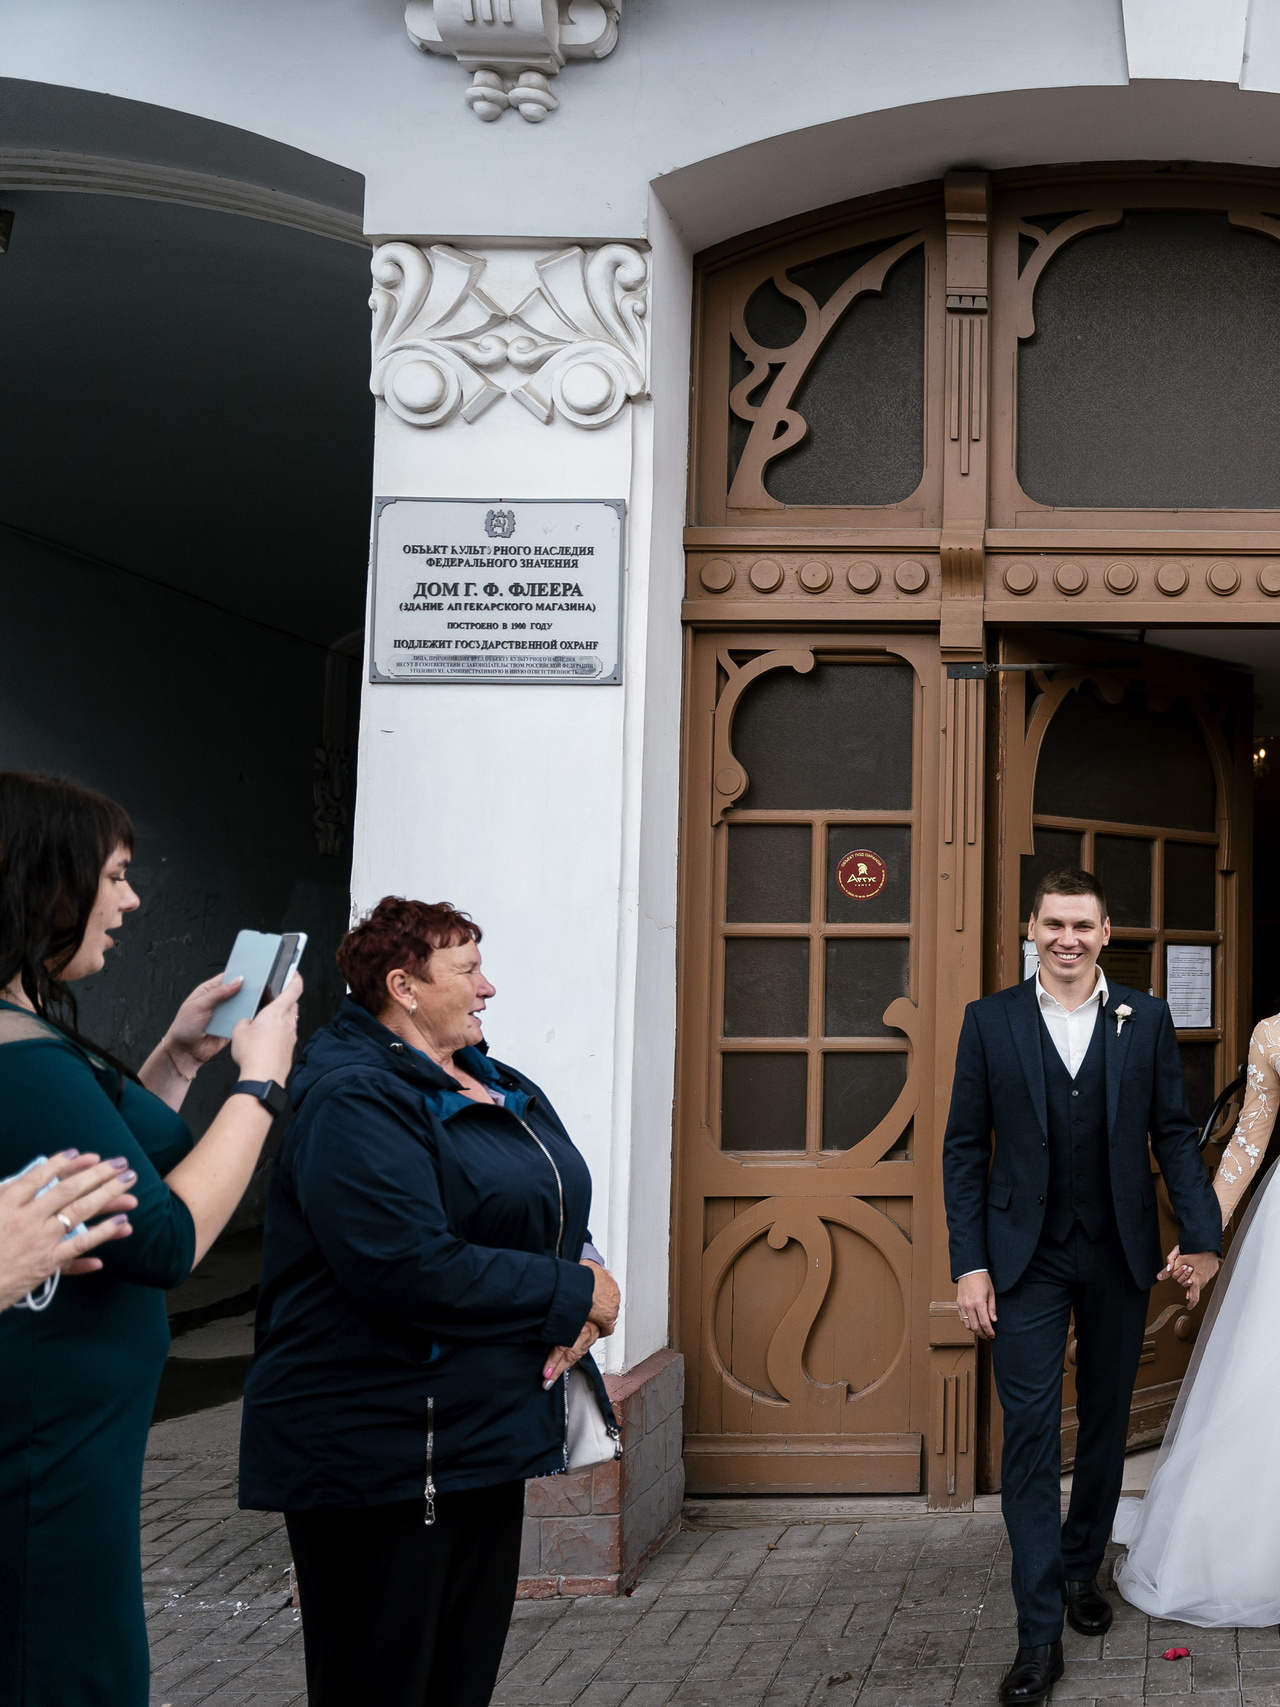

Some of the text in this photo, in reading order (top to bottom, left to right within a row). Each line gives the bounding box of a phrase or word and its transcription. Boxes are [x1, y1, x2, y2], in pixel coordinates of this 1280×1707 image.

[403, 545, 448, 555] ОБЪЕКТ
[534, 546, 594, 556] НАСЛЕДИЯ
[426, 558, 579, 568] ФЕДЕРАЛЬНОГО ЗНАЧЕНИЯ
[413, 583, 583, 599] ДОМ Г. Ф. ФЛЕЕРА
[399, 603, 443, 612] (ЗДАНИЕ
[536, 603, 596, 612] МАГАЗИНА)
[447, 622, 498, 630] ПОСТРОЕНО
[530, 623, 553, 631] ГОДУ
[394, 640, 452, 650] ПОДЛЕЖИТ
[455, 640, 557, 649] ГОСУДАРСТВЕННОЙ
